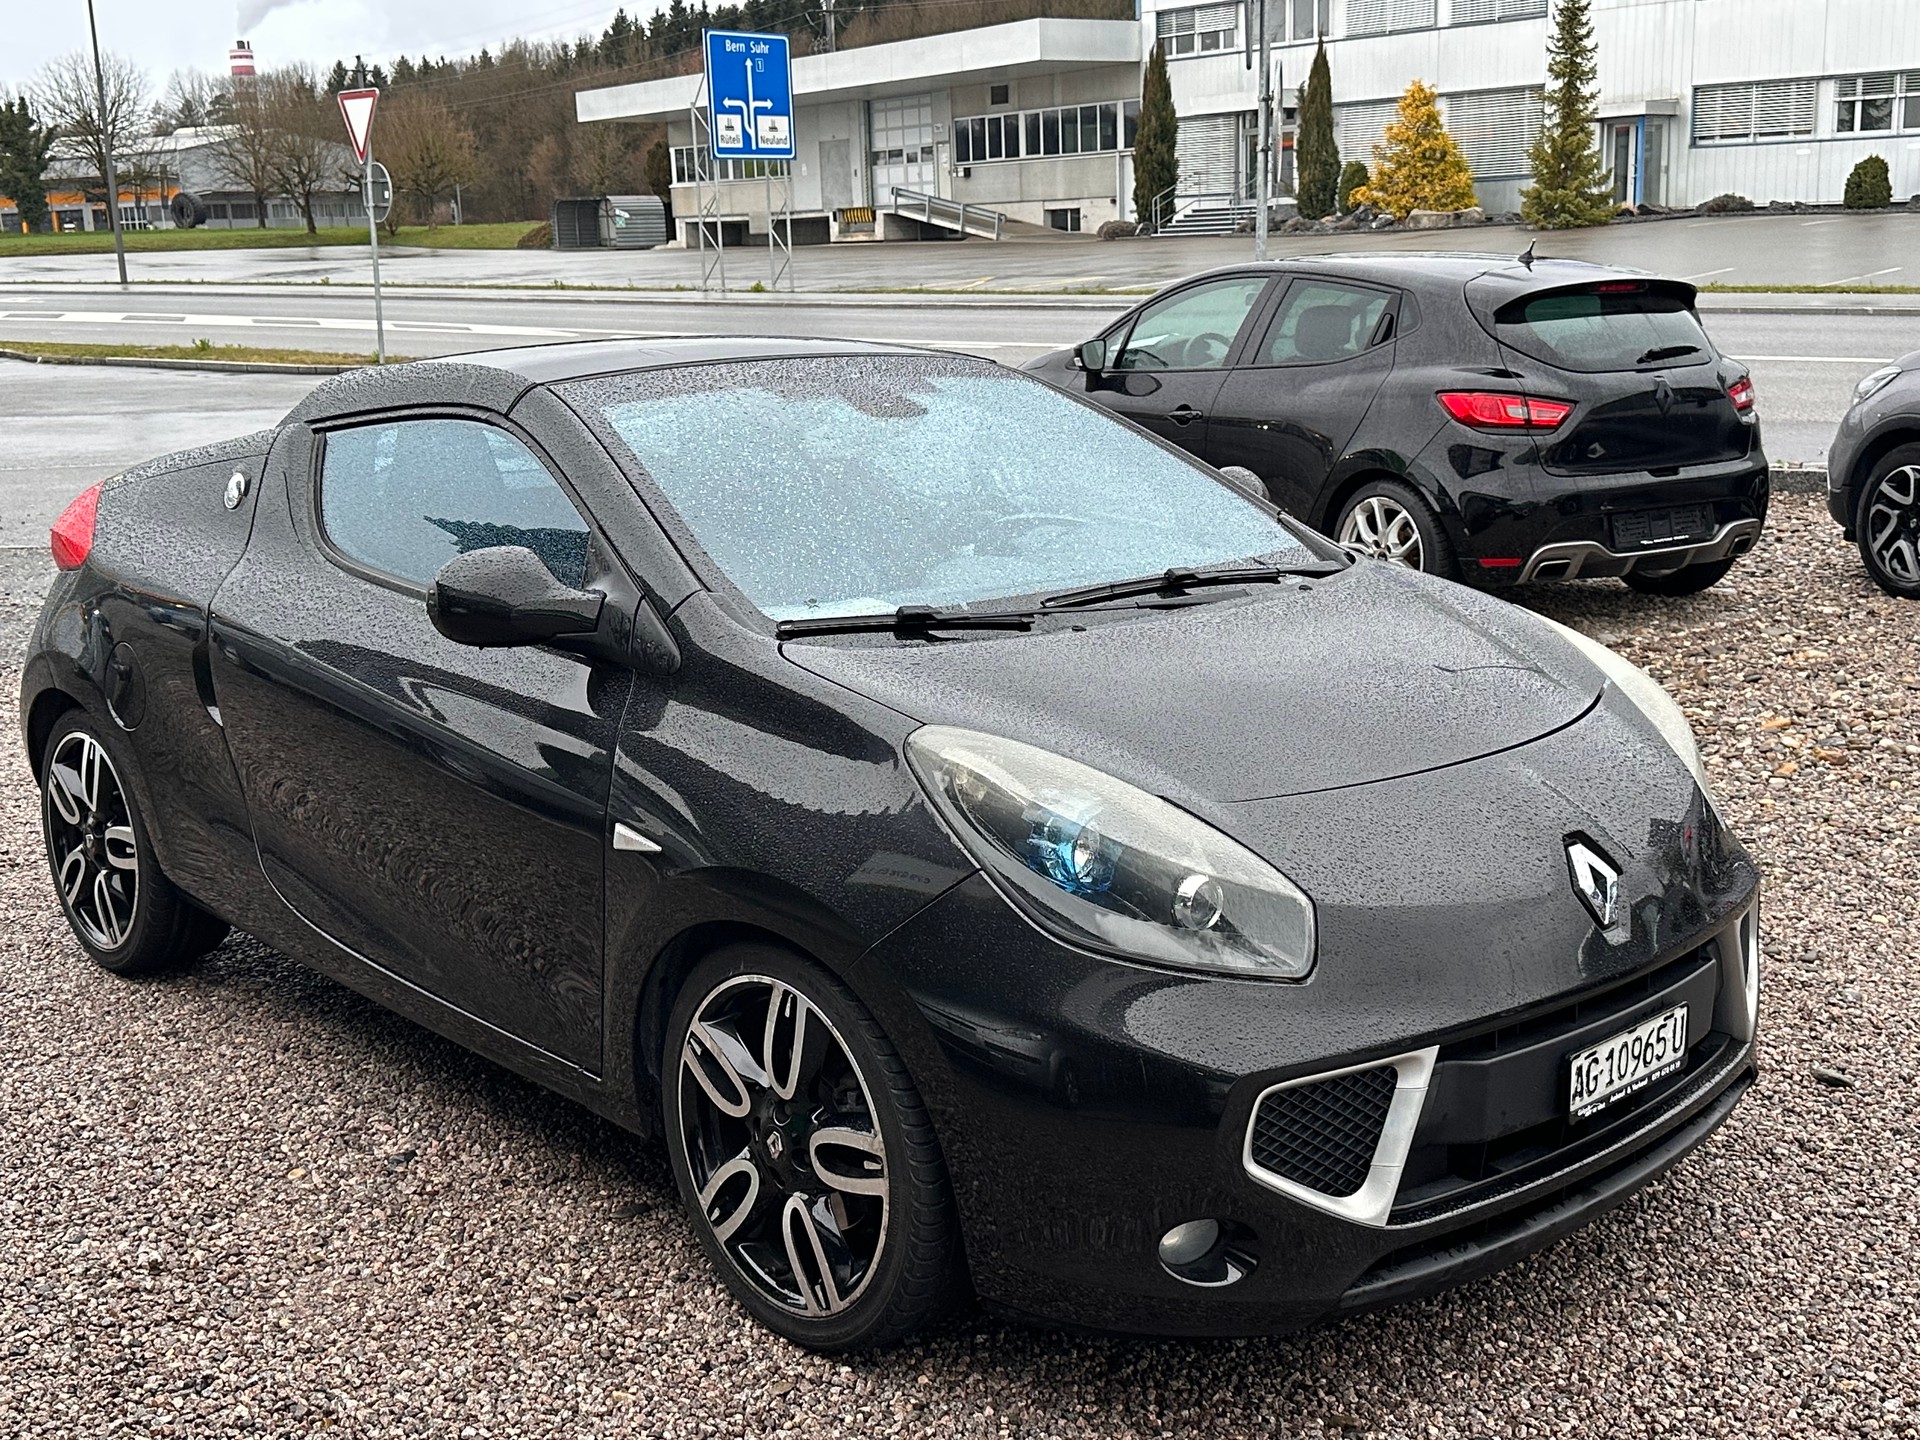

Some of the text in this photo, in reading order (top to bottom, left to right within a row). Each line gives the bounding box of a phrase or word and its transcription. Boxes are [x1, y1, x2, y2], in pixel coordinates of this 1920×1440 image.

[725, 39, 770, 54] Bern Suhr
[760, 135, 788, 146] Neuland
